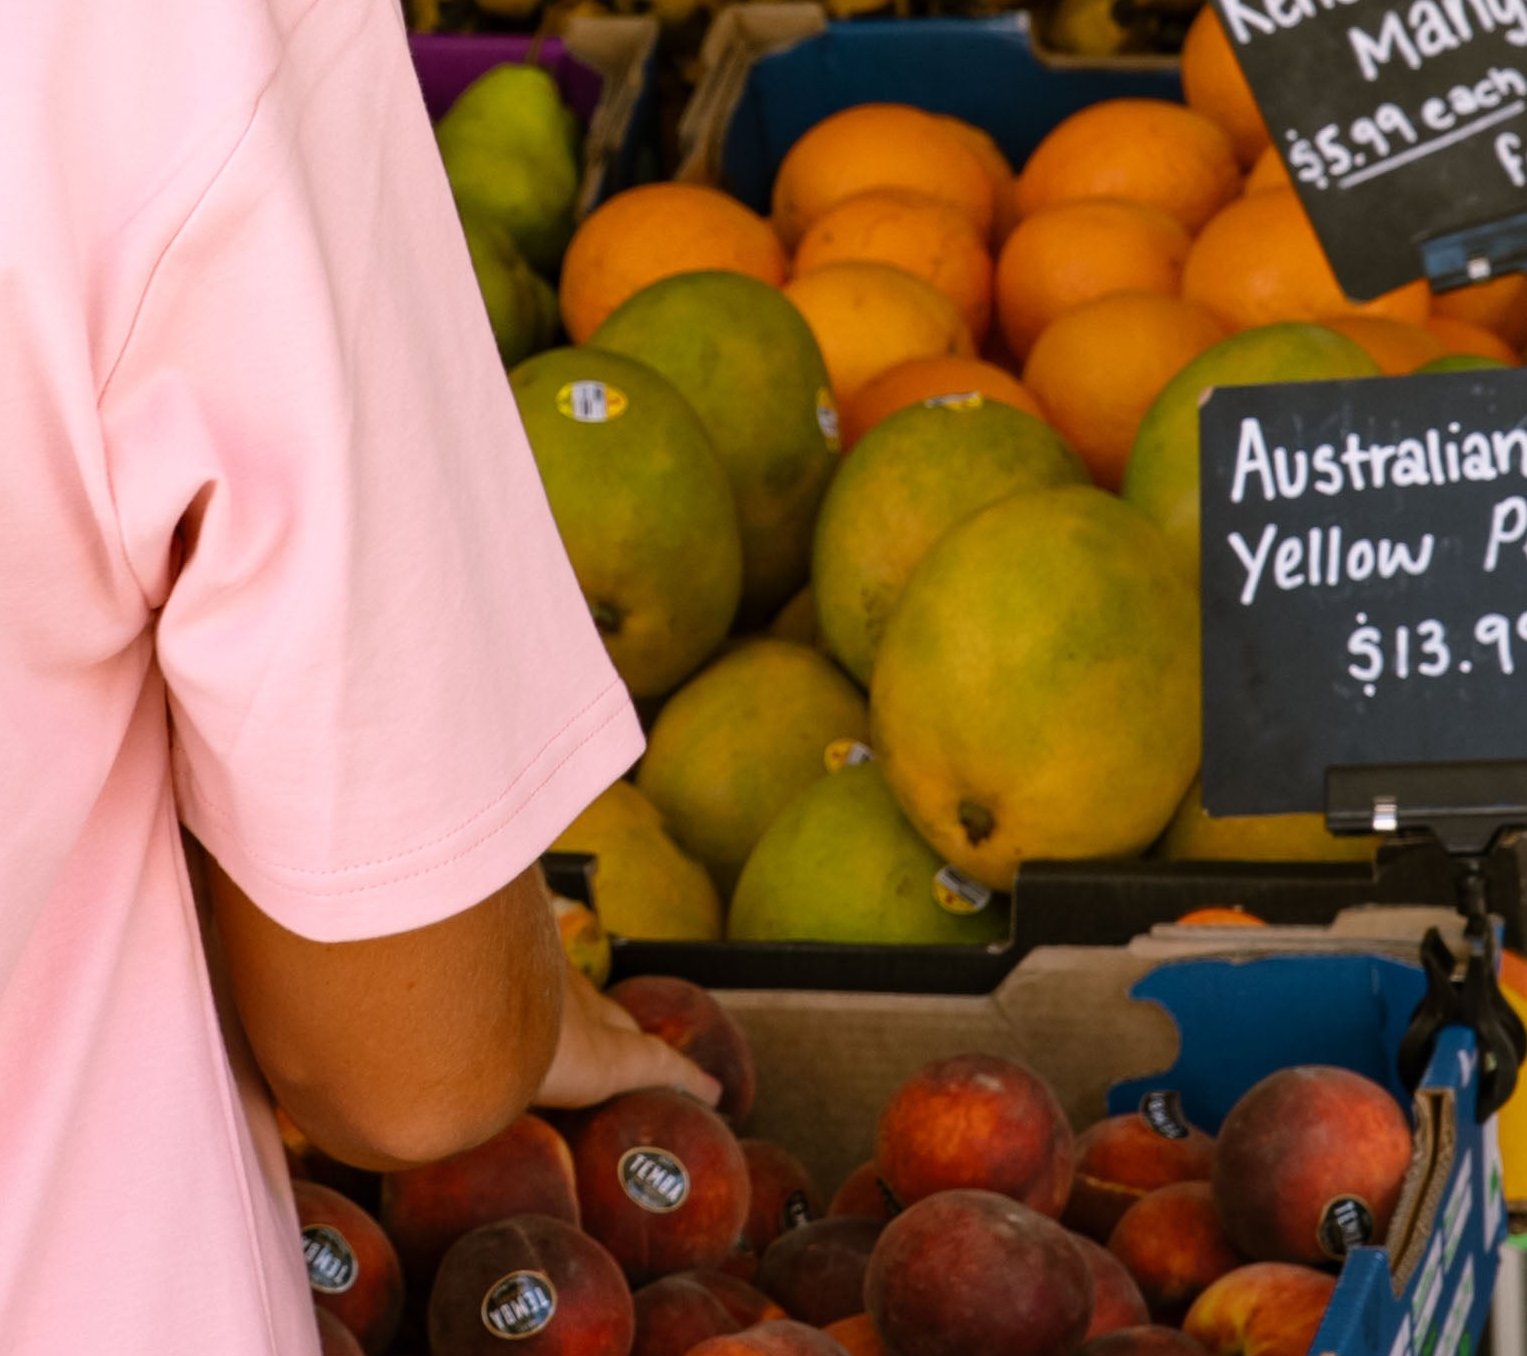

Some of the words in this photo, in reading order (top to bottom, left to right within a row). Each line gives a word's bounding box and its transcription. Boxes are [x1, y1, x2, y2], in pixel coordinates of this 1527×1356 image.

[1285, 104, 1418, 190] $5.99
[1421, 68, 1527, 130] each
[1231, 418, 1527, 503] Australian
[1227, 524, 1435, 605] Yellow
